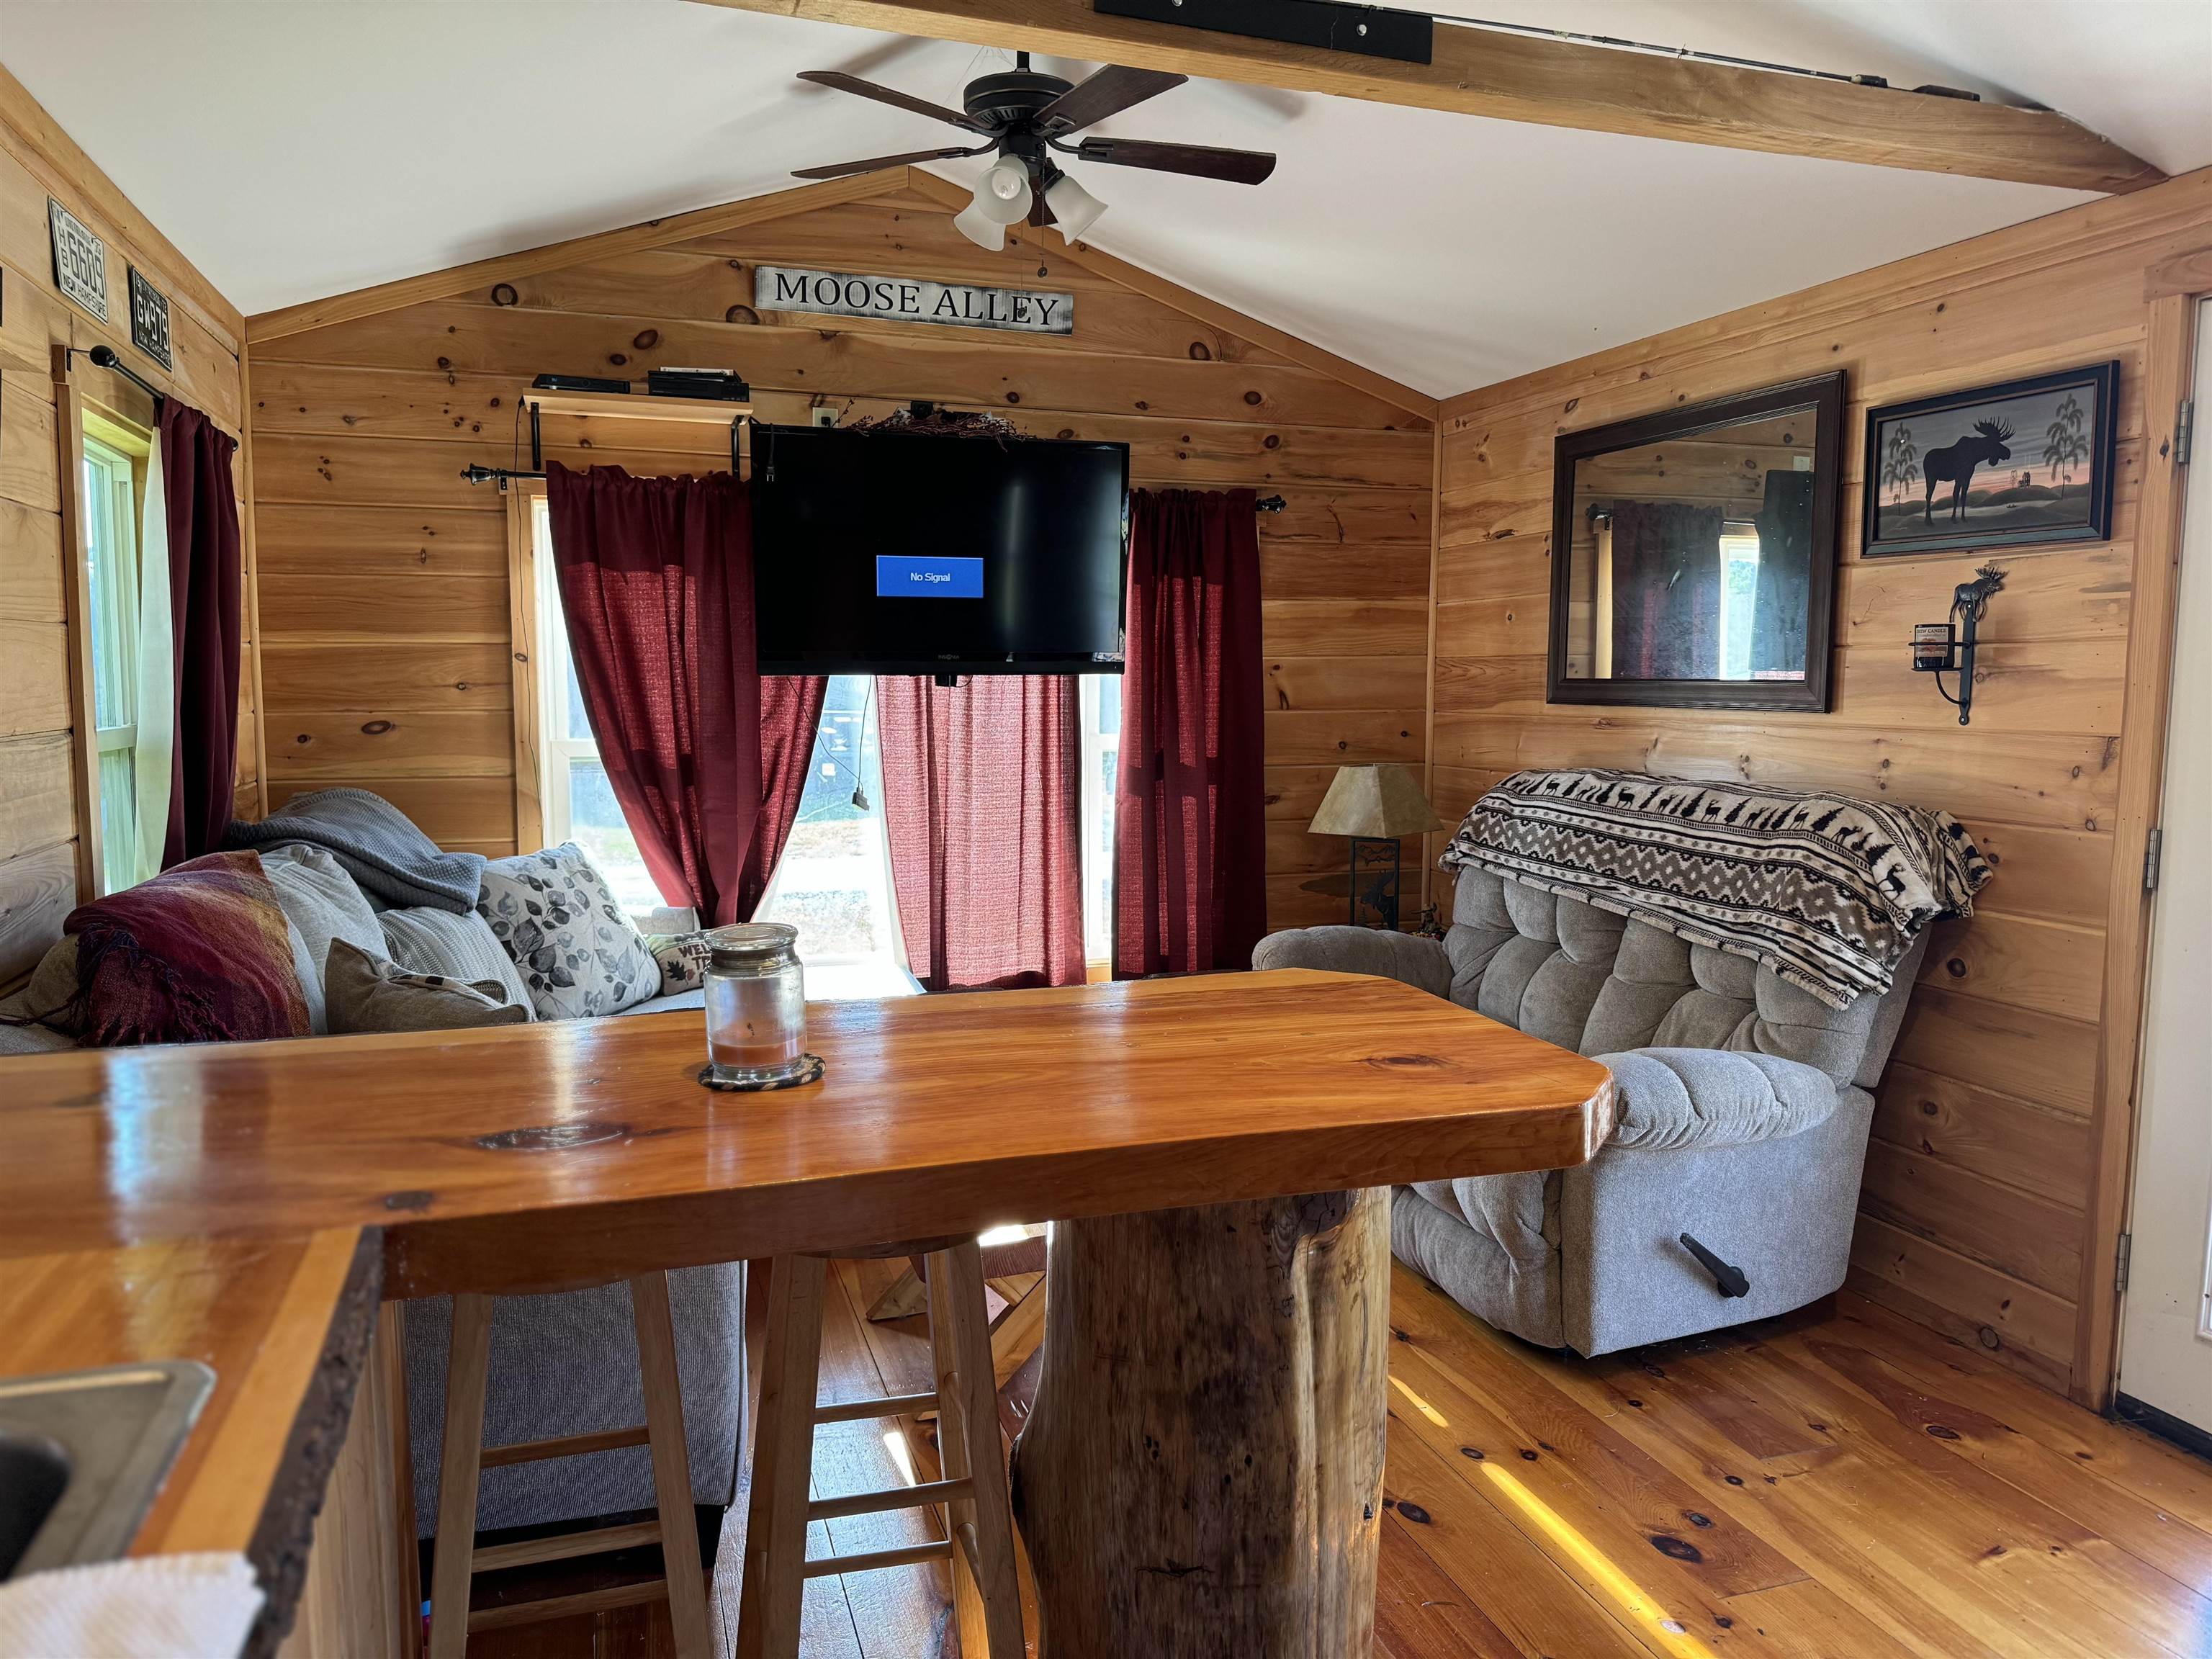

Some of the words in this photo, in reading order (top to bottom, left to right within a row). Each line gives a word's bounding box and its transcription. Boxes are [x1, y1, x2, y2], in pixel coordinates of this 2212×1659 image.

[63, 273, 76, 292] NEW
[67, 230, 105, 301] 6609
[137, 292, 169, 352] GW979
[775, 272, 920, 314] MOOSE
[932, 289, 1058, 325] ALLEY
[910, 572, 923, 581] No
[925, 572, 950, 583] Signal
